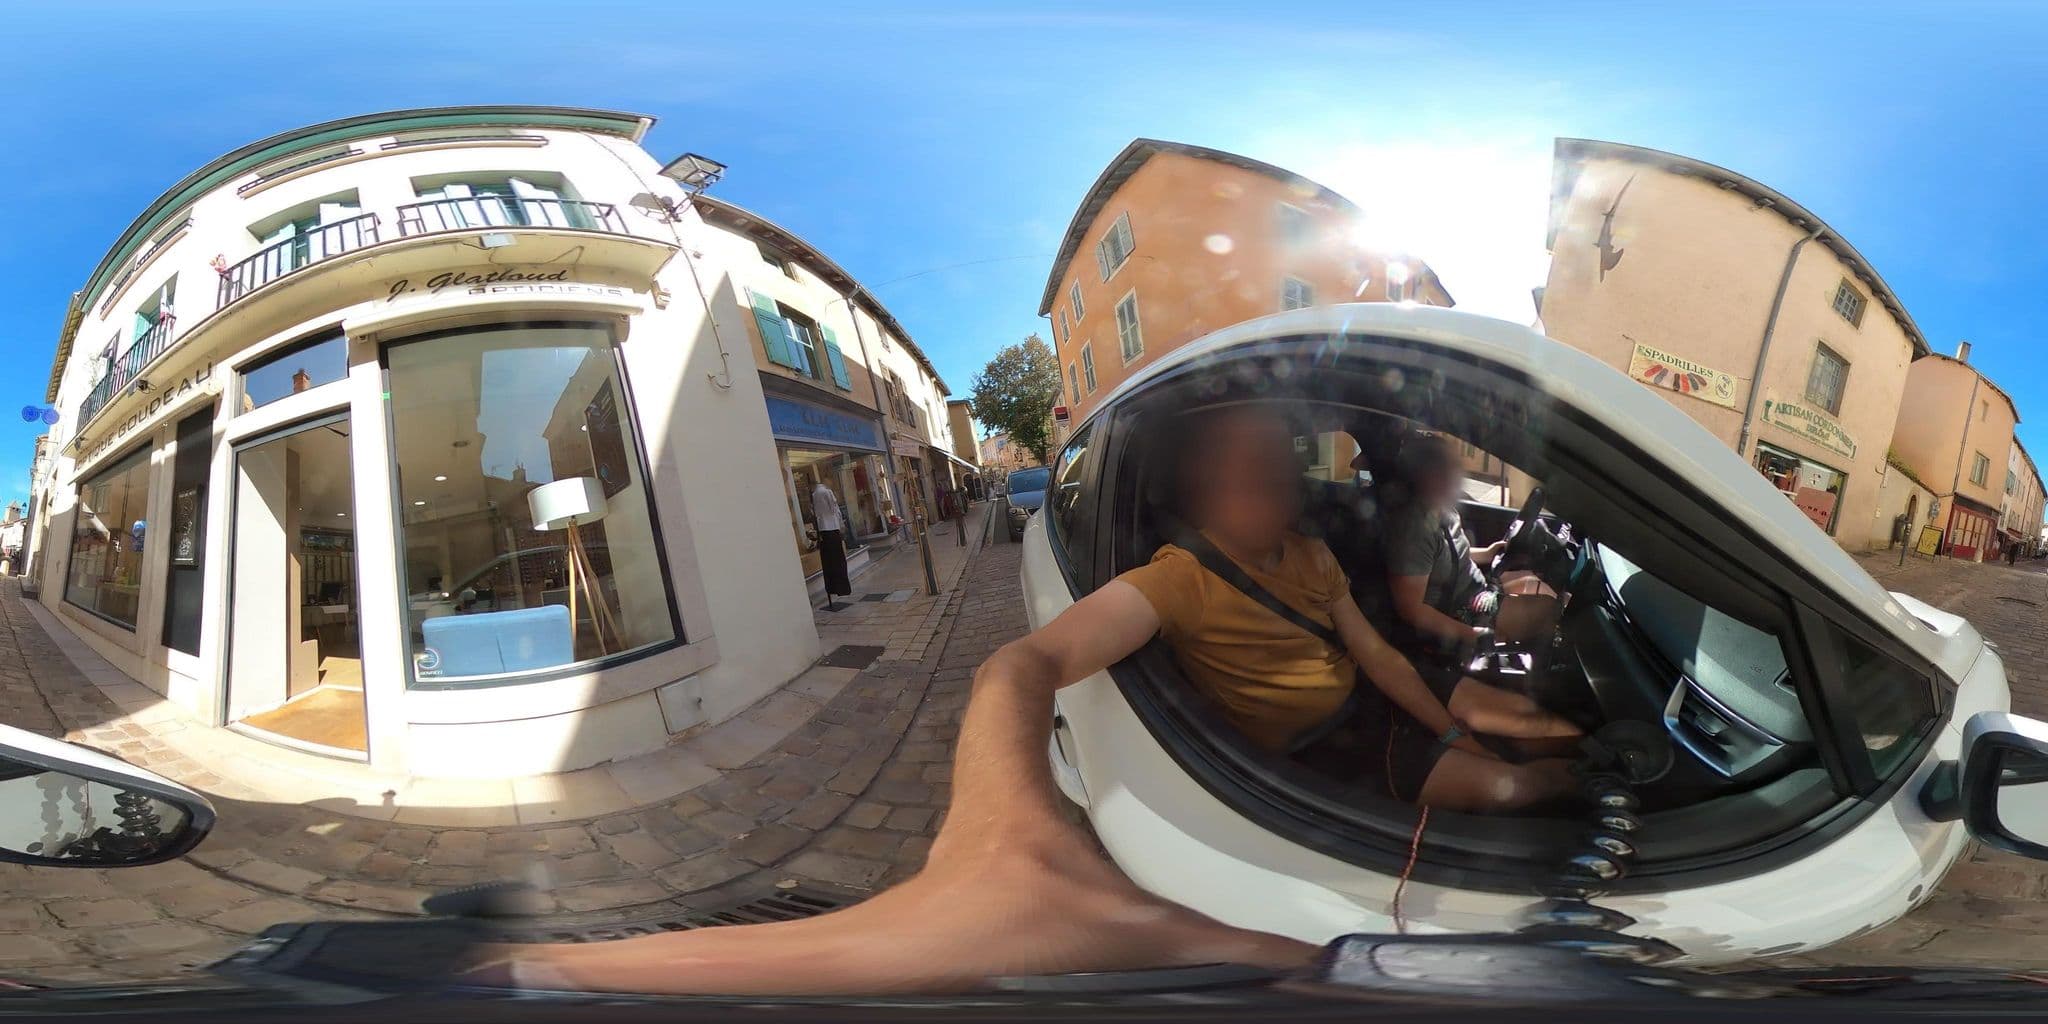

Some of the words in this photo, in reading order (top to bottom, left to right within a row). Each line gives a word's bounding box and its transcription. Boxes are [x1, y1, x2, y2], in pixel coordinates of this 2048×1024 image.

[386, 278, 416, 302] J.
[1637, 344, 1715, 379] ESPADRILLES
[118, 361, 212, 438] GOUDEAU
[1774, 403, 1813, 421] ARTISAN
